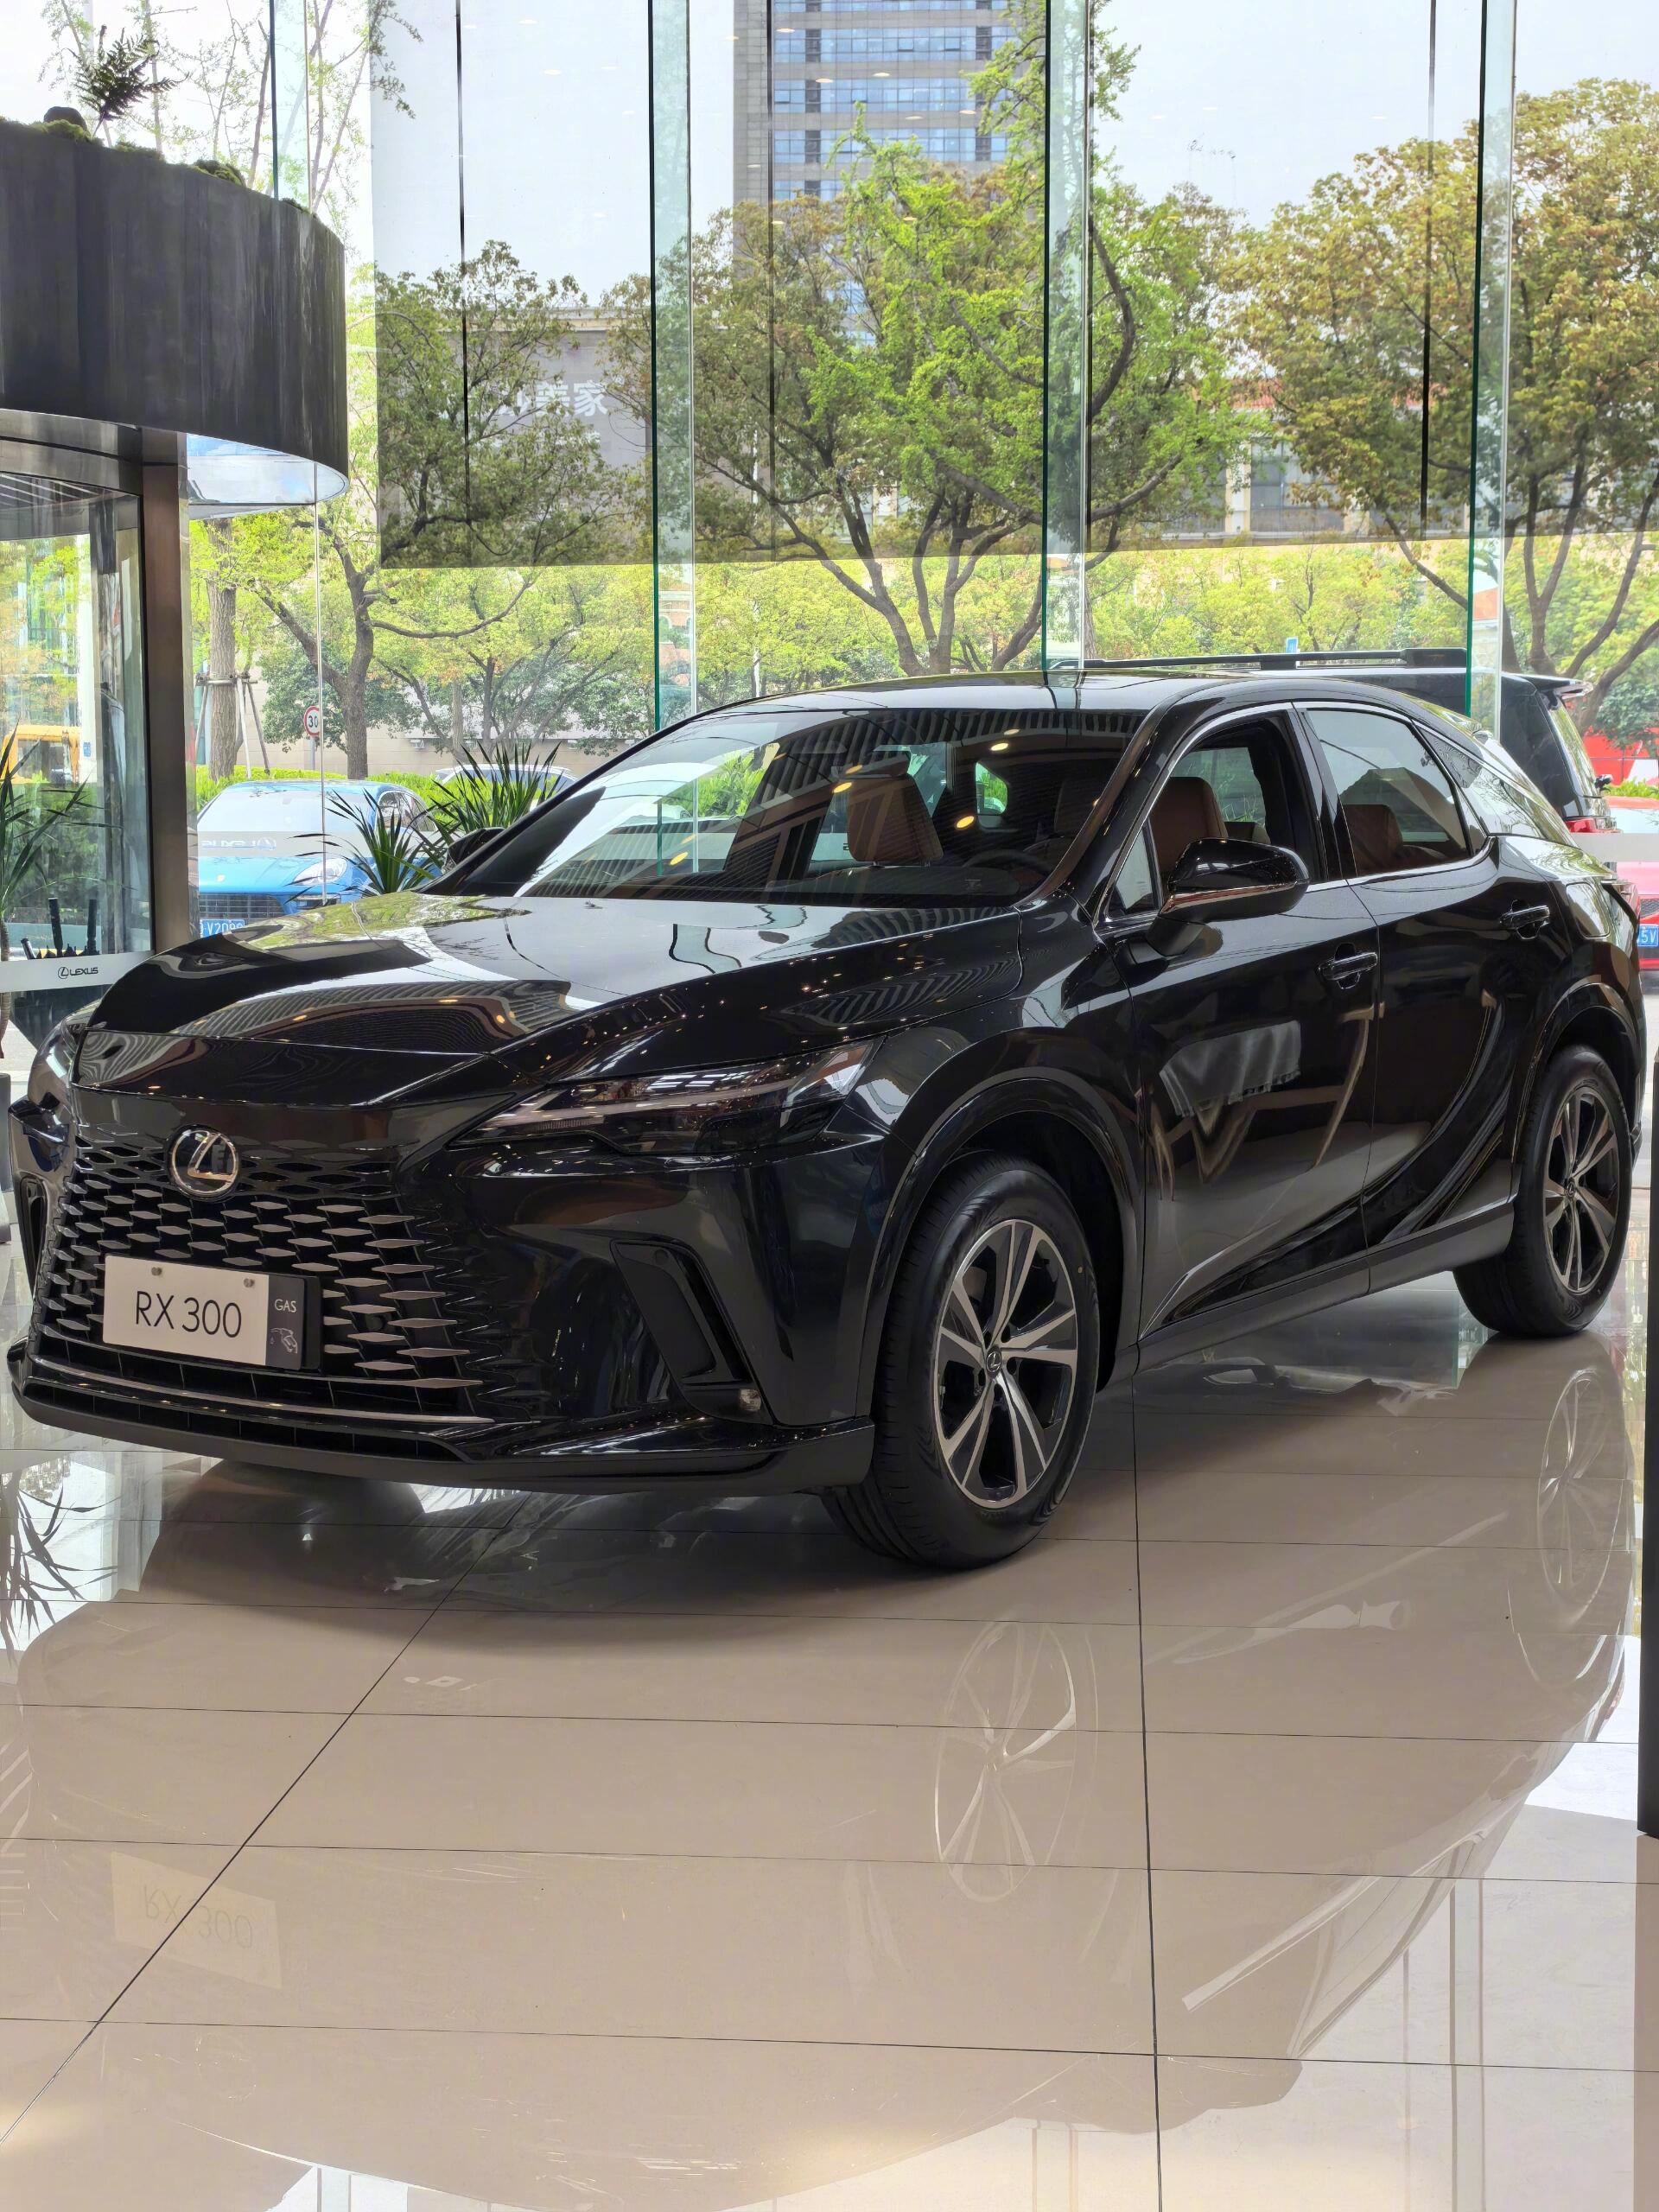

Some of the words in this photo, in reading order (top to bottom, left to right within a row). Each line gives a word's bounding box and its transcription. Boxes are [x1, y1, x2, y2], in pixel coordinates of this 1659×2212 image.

[308, 715, 319, 728] 30
[70, 967, 99, 976] LEXUS
[274, 1299, 297, 1313] GAS
[136, 1291, 175, 1330] RX
[181, 1297, 242, 1338] 300
